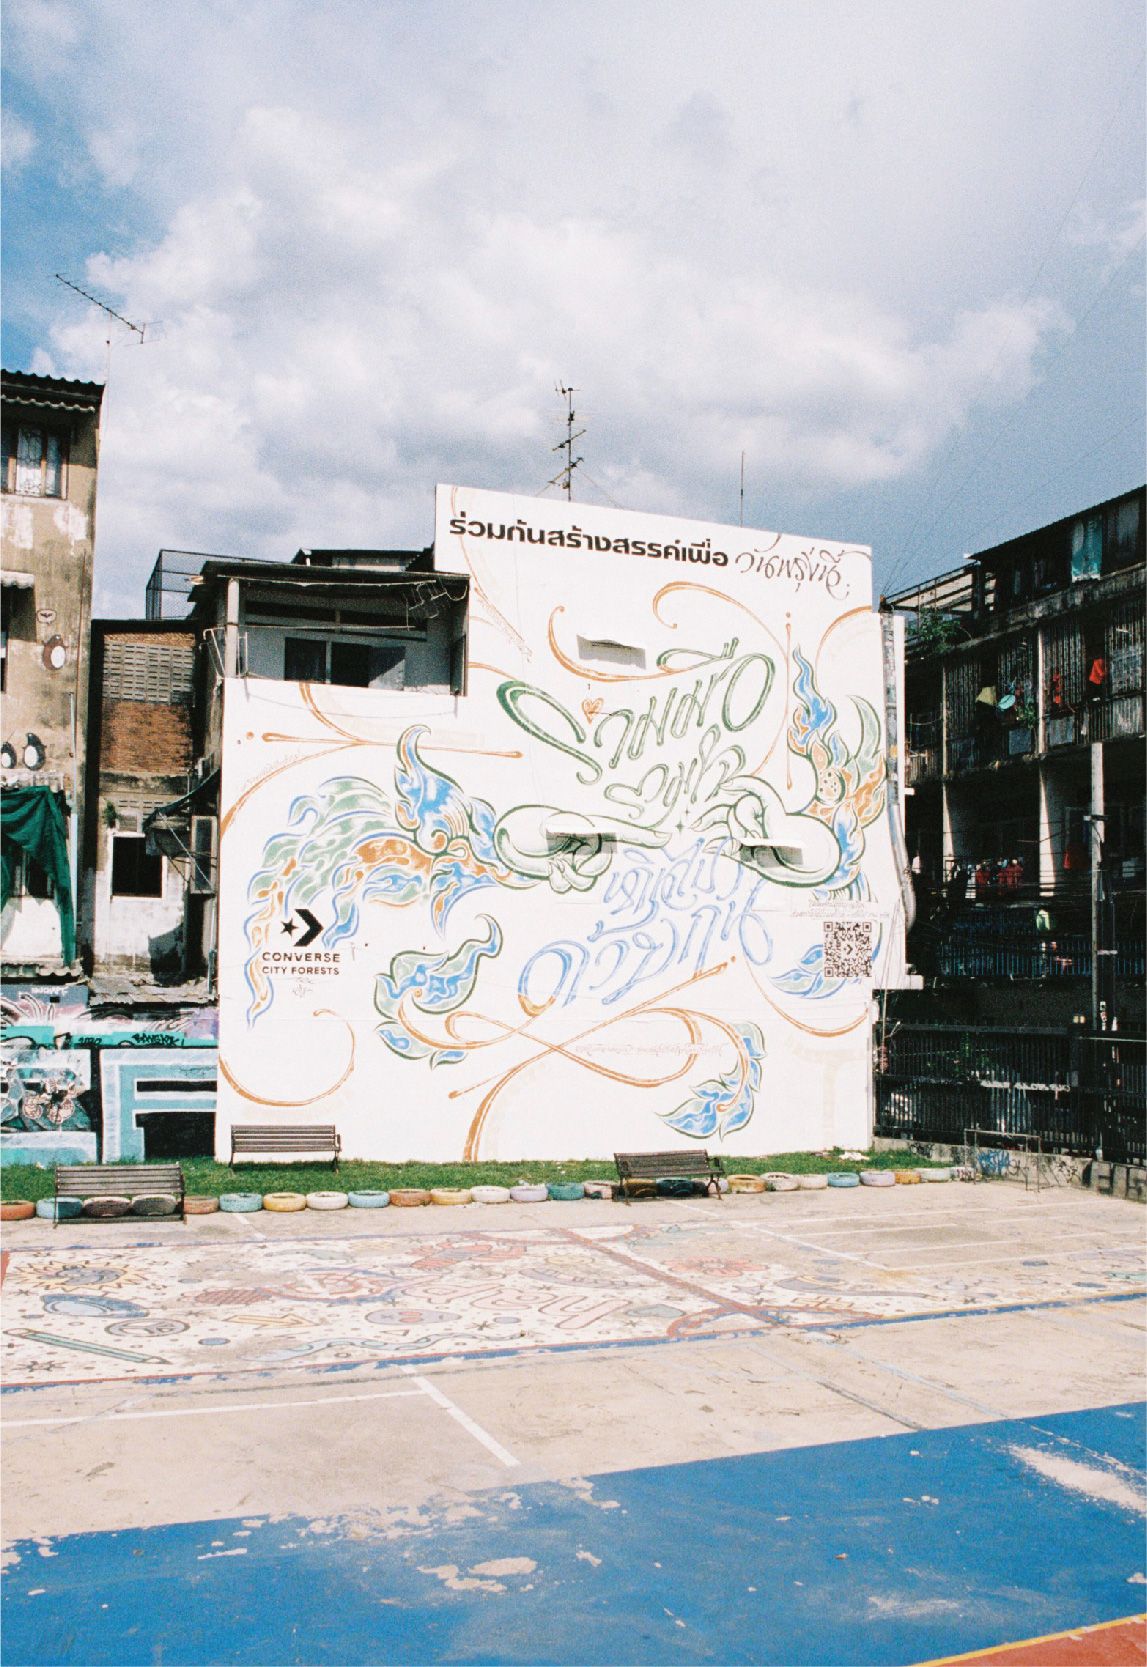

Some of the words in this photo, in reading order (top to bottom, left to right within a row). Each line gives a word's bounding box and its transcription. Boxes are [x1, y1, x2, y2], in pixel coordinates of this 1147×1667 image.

[449, 511, 729, 567] ร่วมกันสร้างสรรค์เพื่อ
[262, 952, 341, 963] CONVERSE
[262, 966, 288, 975] CITY
[291, 967, 340, 976] FORESTS
